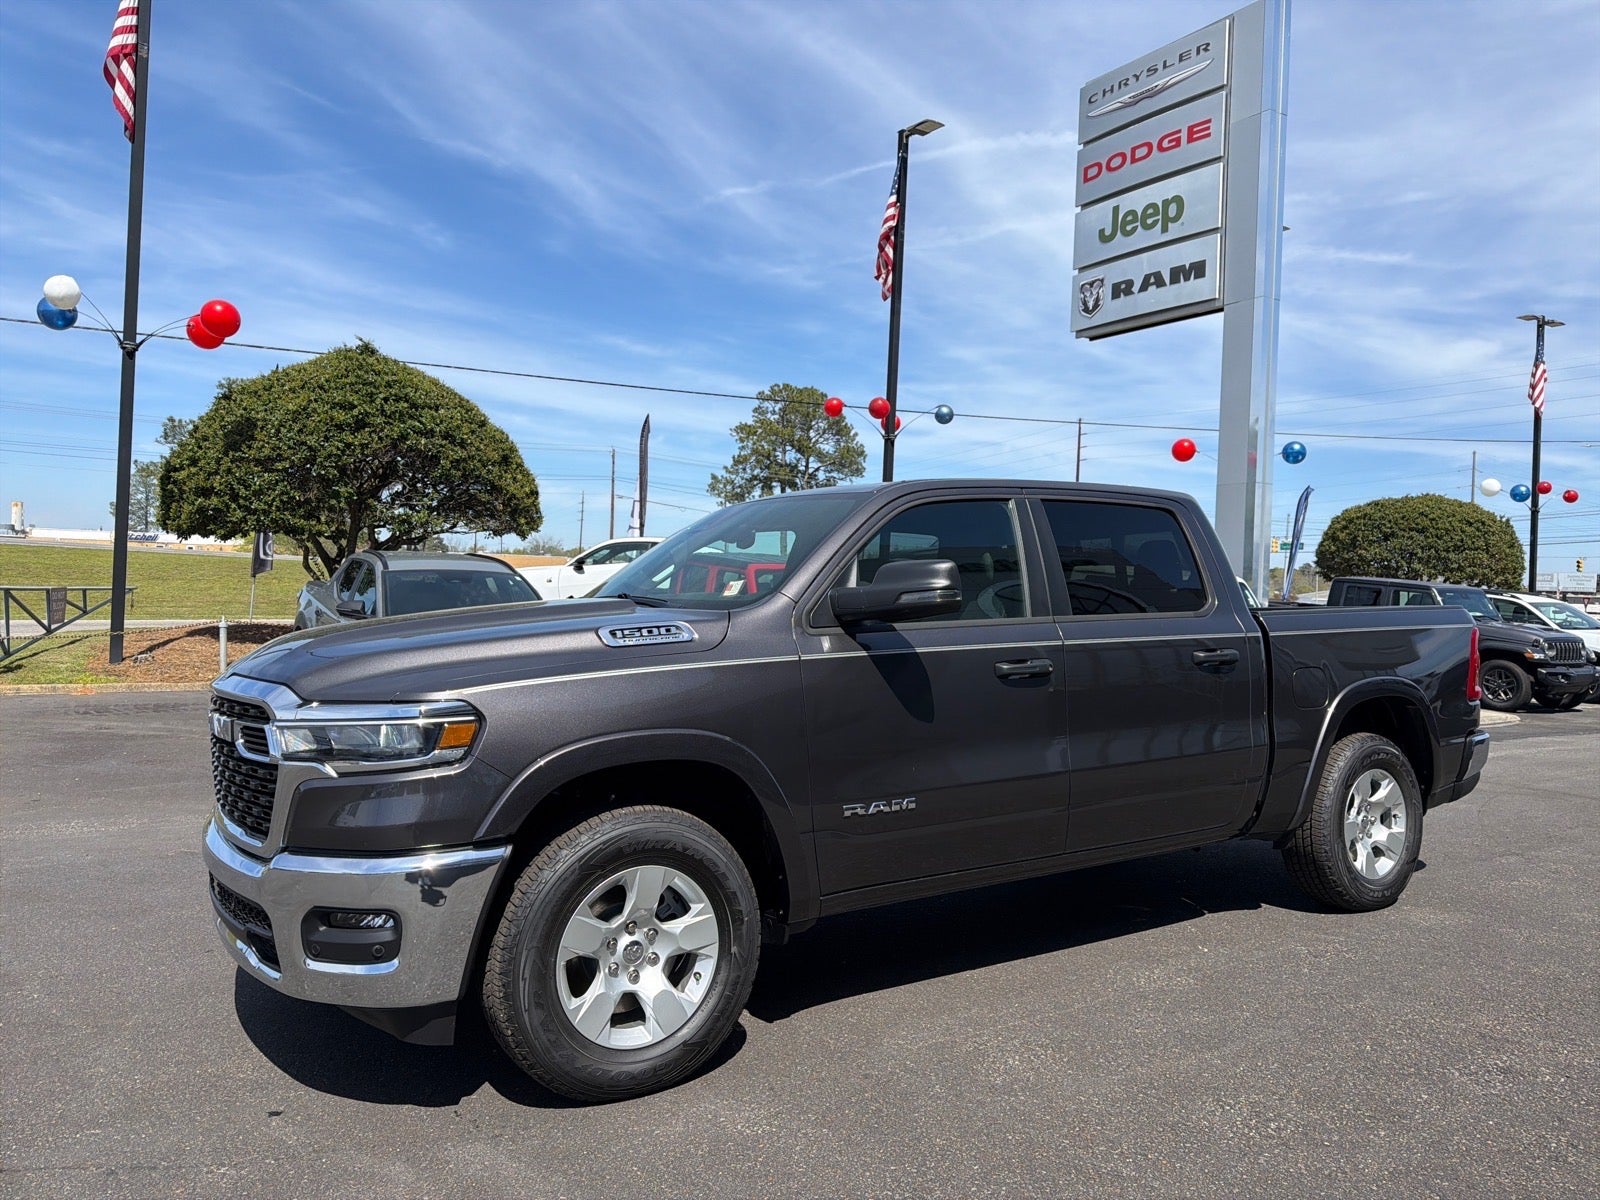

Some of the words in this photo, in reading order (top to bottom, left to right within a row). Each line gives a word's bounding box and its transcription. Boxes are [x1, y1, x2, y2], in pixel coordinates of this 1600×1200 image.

[1087, 41, 1211, 105] CHRYSLER
[1083, 118, 1212, 184] DODGE
[1098, 194, 1185, 243] Jeep
[1111, 259, 1206, 301] RAM
[614, 626, 677, 638] 1500
[842, 797, 916, 817] RAM
